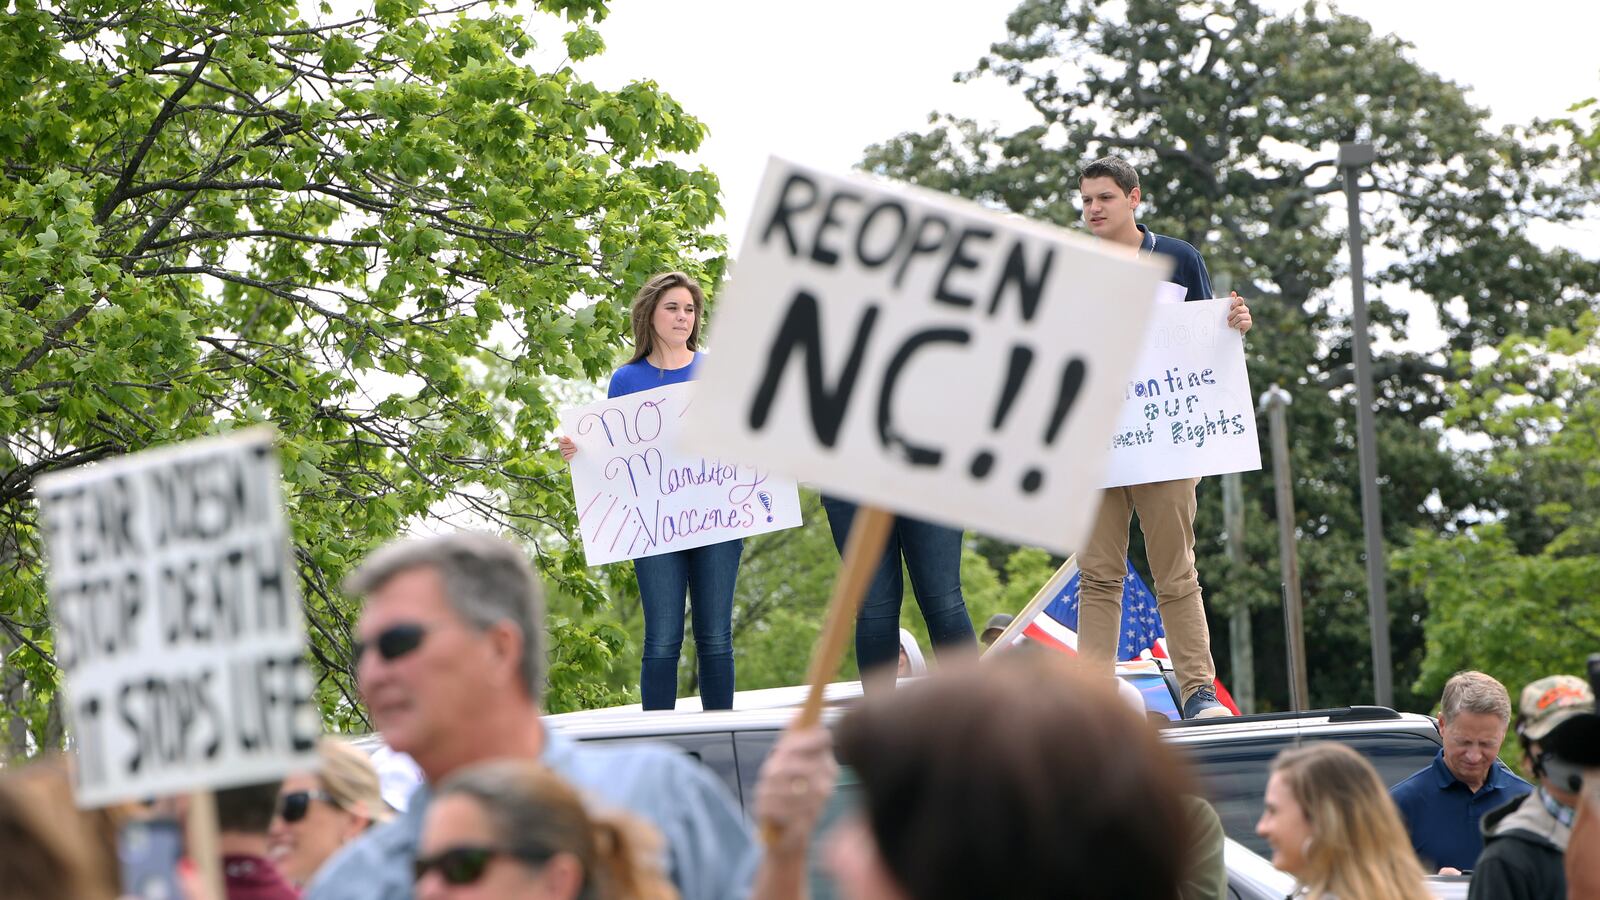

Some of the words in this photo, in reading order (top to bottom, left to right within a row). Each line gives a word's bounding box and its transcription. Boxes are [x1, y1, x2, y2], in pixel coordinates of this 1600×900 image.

[759, 173, 1055, 323] REOPEN
[746, 286, 1088, 495] NC!!
[1112, 422, 1155, 448] ment
[1171, 410, 1246, 448] Rights
[1124, 367, 1216, 400] rantine
[1144, 395, 1199, 420] our
[55, 569, 143, 669] STOP
[160, 536, 287, 646] DEATH
[117, 668, 222, 775] STOPS
[228, 653, 317, 756] LIFE
